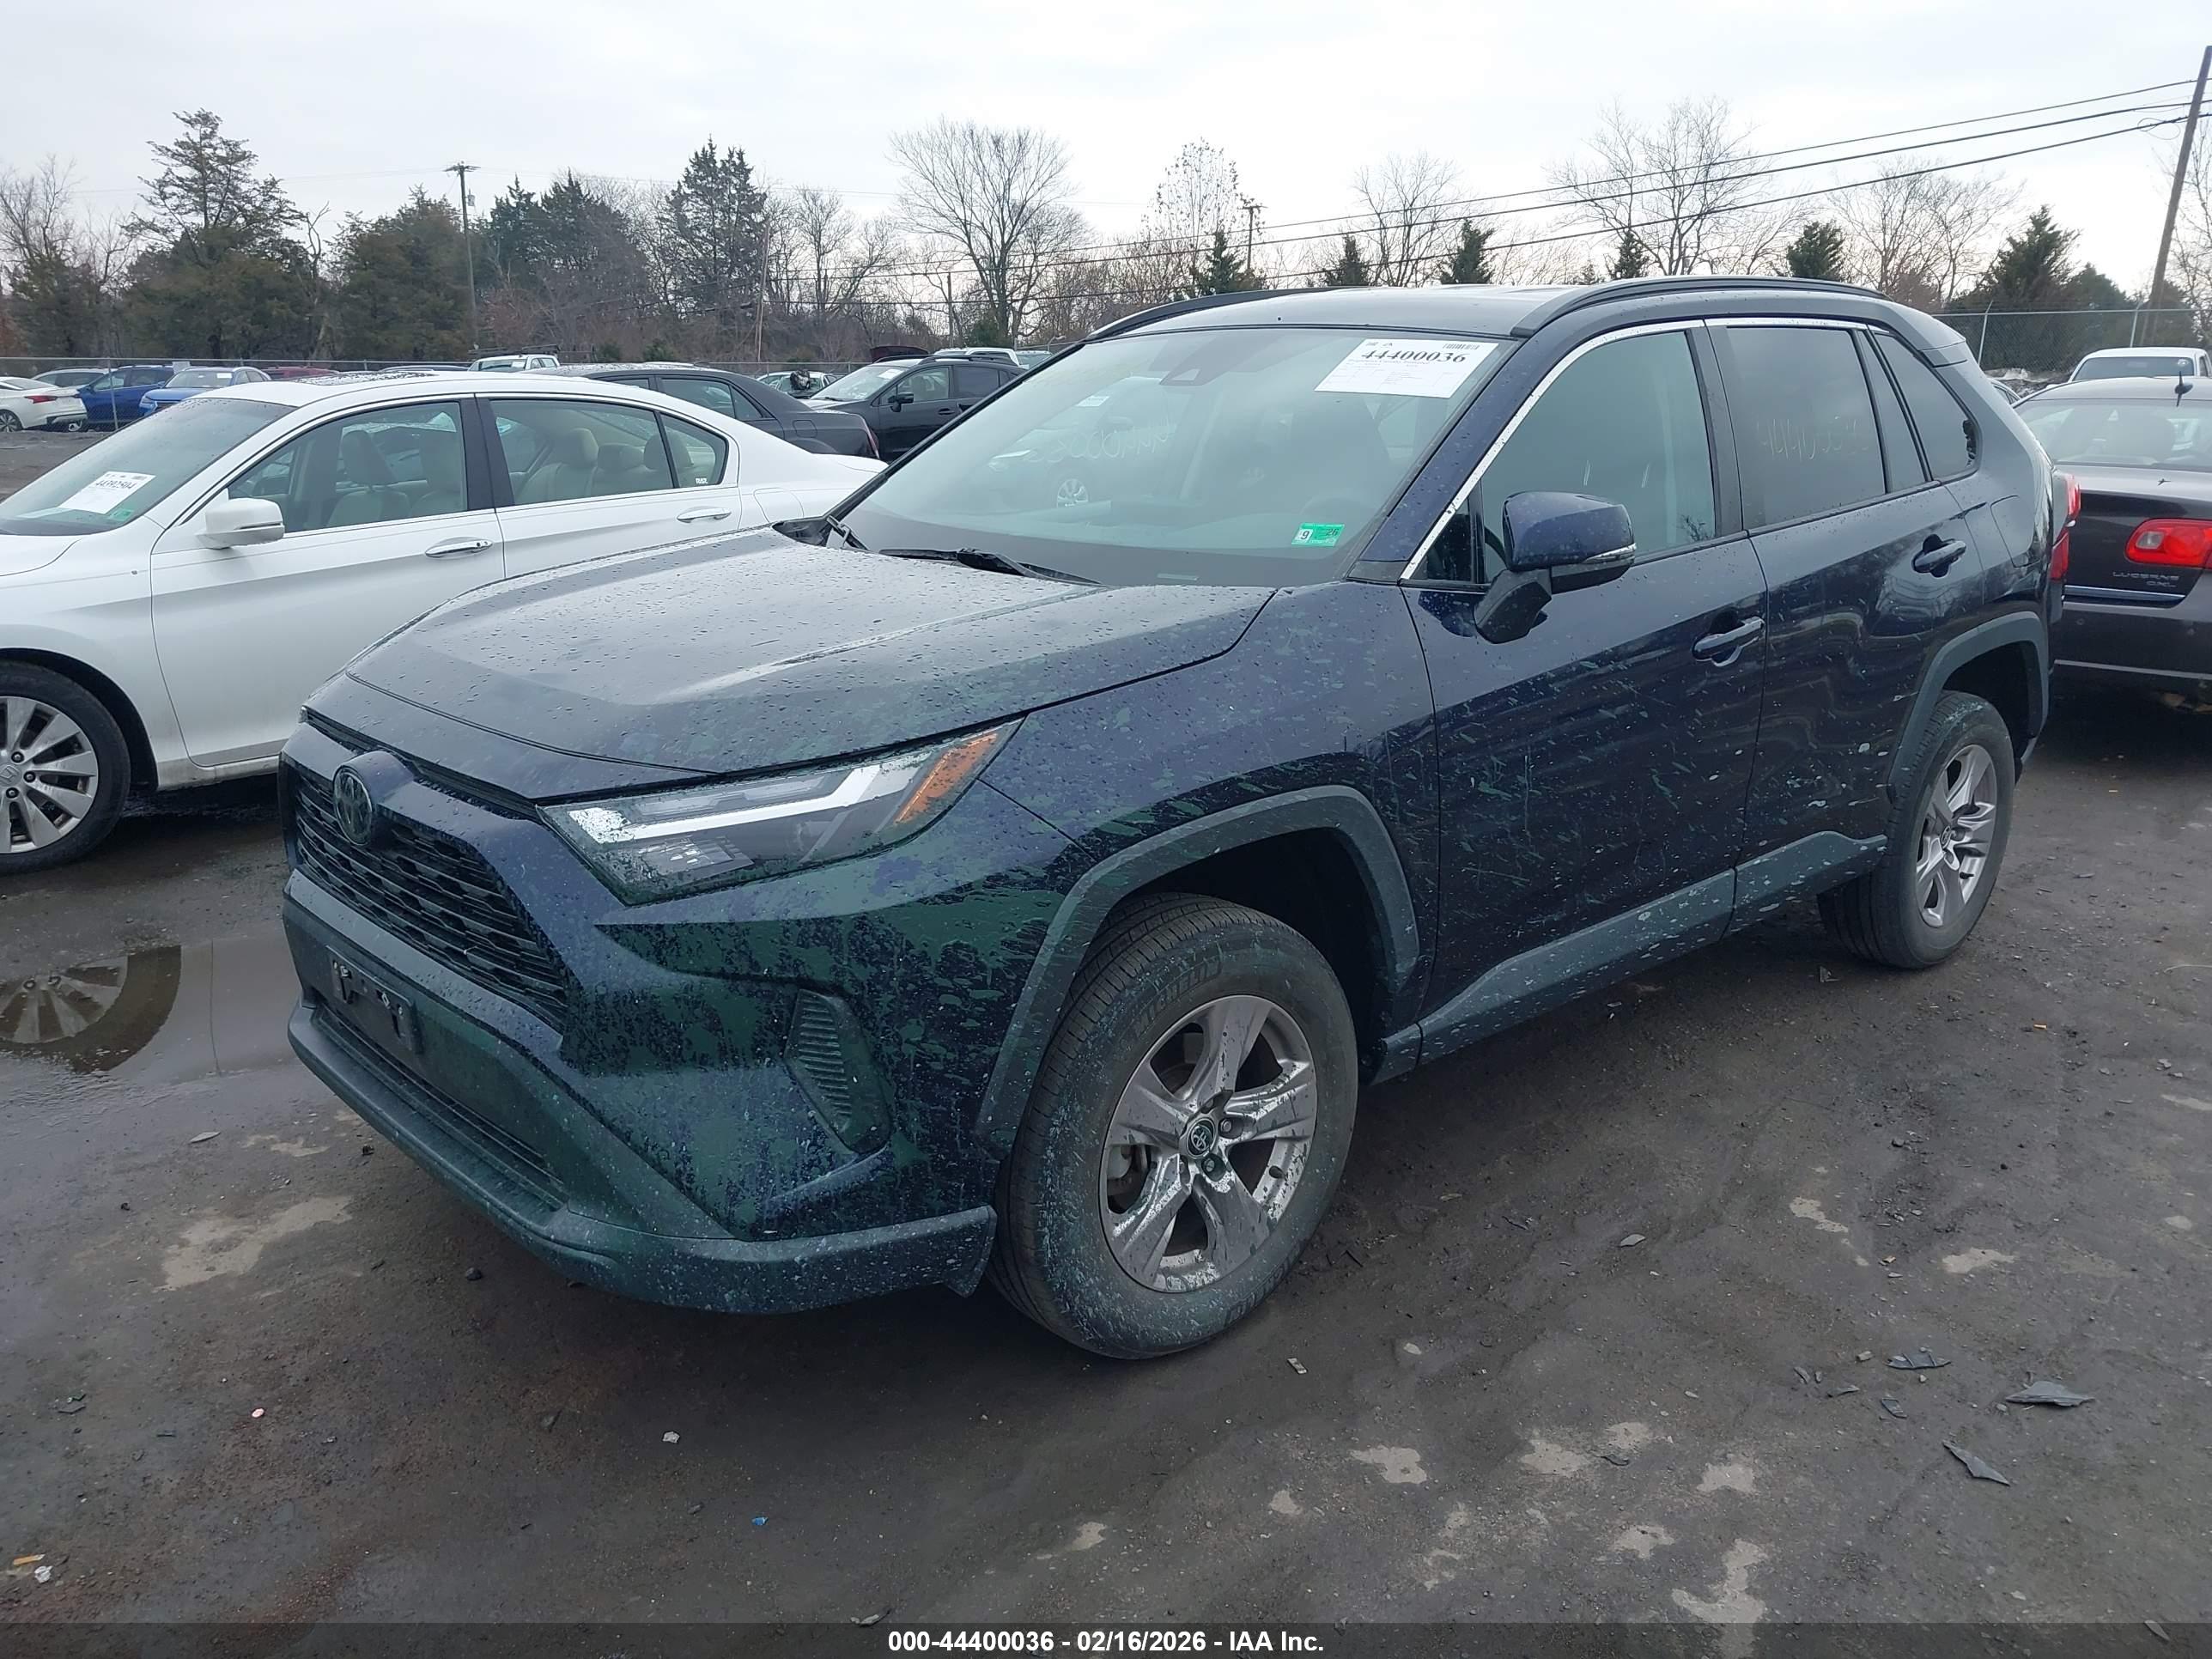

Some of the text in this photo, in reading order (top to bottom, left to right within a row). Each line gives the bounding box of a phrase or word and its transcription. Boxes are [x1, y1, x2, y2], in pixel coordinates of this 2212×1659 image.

[1361, 349, 1469, 363] 44400036
[1301, 530, 1310, 540] 9
[2112, 572, 2179, 580] LUCERNE
